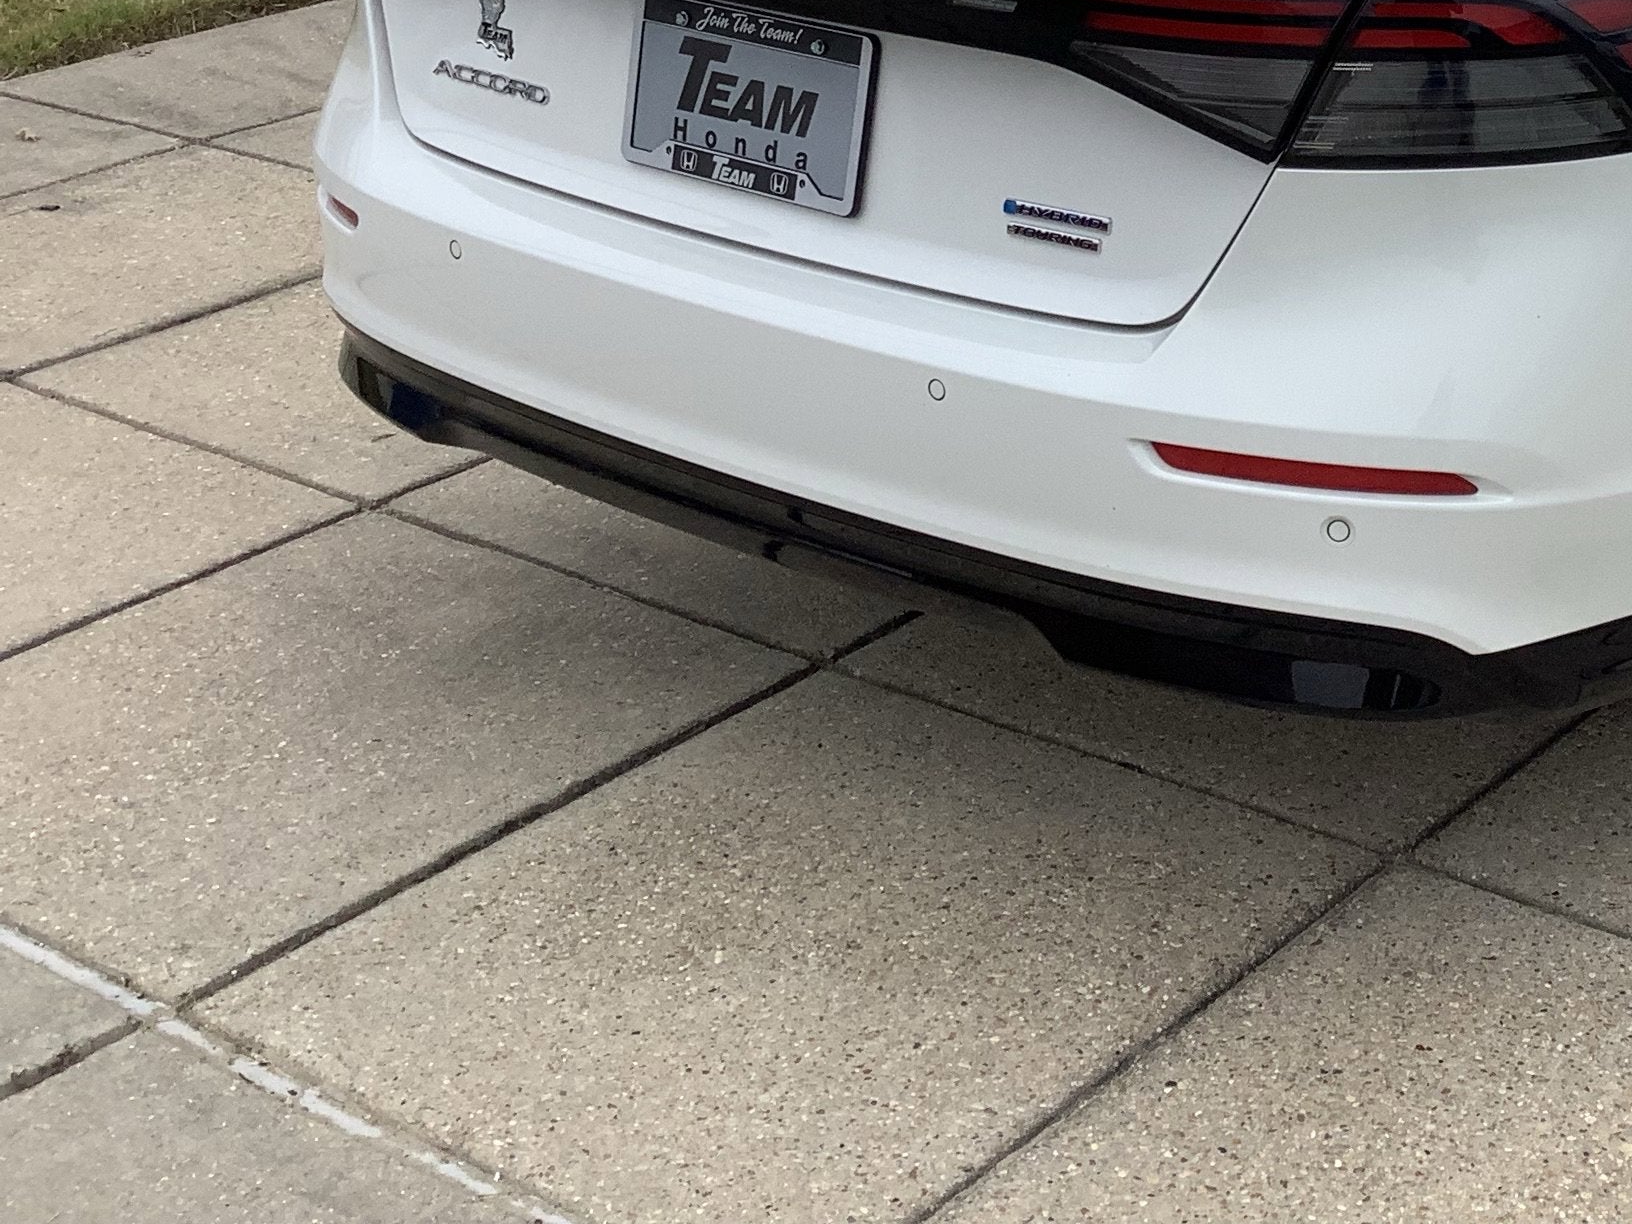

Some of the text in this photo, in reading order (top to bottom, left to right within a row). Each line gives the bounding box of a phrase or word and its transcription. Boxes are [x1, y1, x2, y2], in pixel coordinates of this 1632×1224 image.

[481, 21, 509, 45] TEAM
[695, 6, 804, 45] Join The Team!
[432, 60, 551, 106] ACCORD
[676, 35, 820, 139] TEAM
[672, 116, 808, 172] Honda
[711, 154, 756, 189] TEAM
[1016, 203, 1104, 231] HYBRID
[1011, 224, 1094, 251] TOURING
